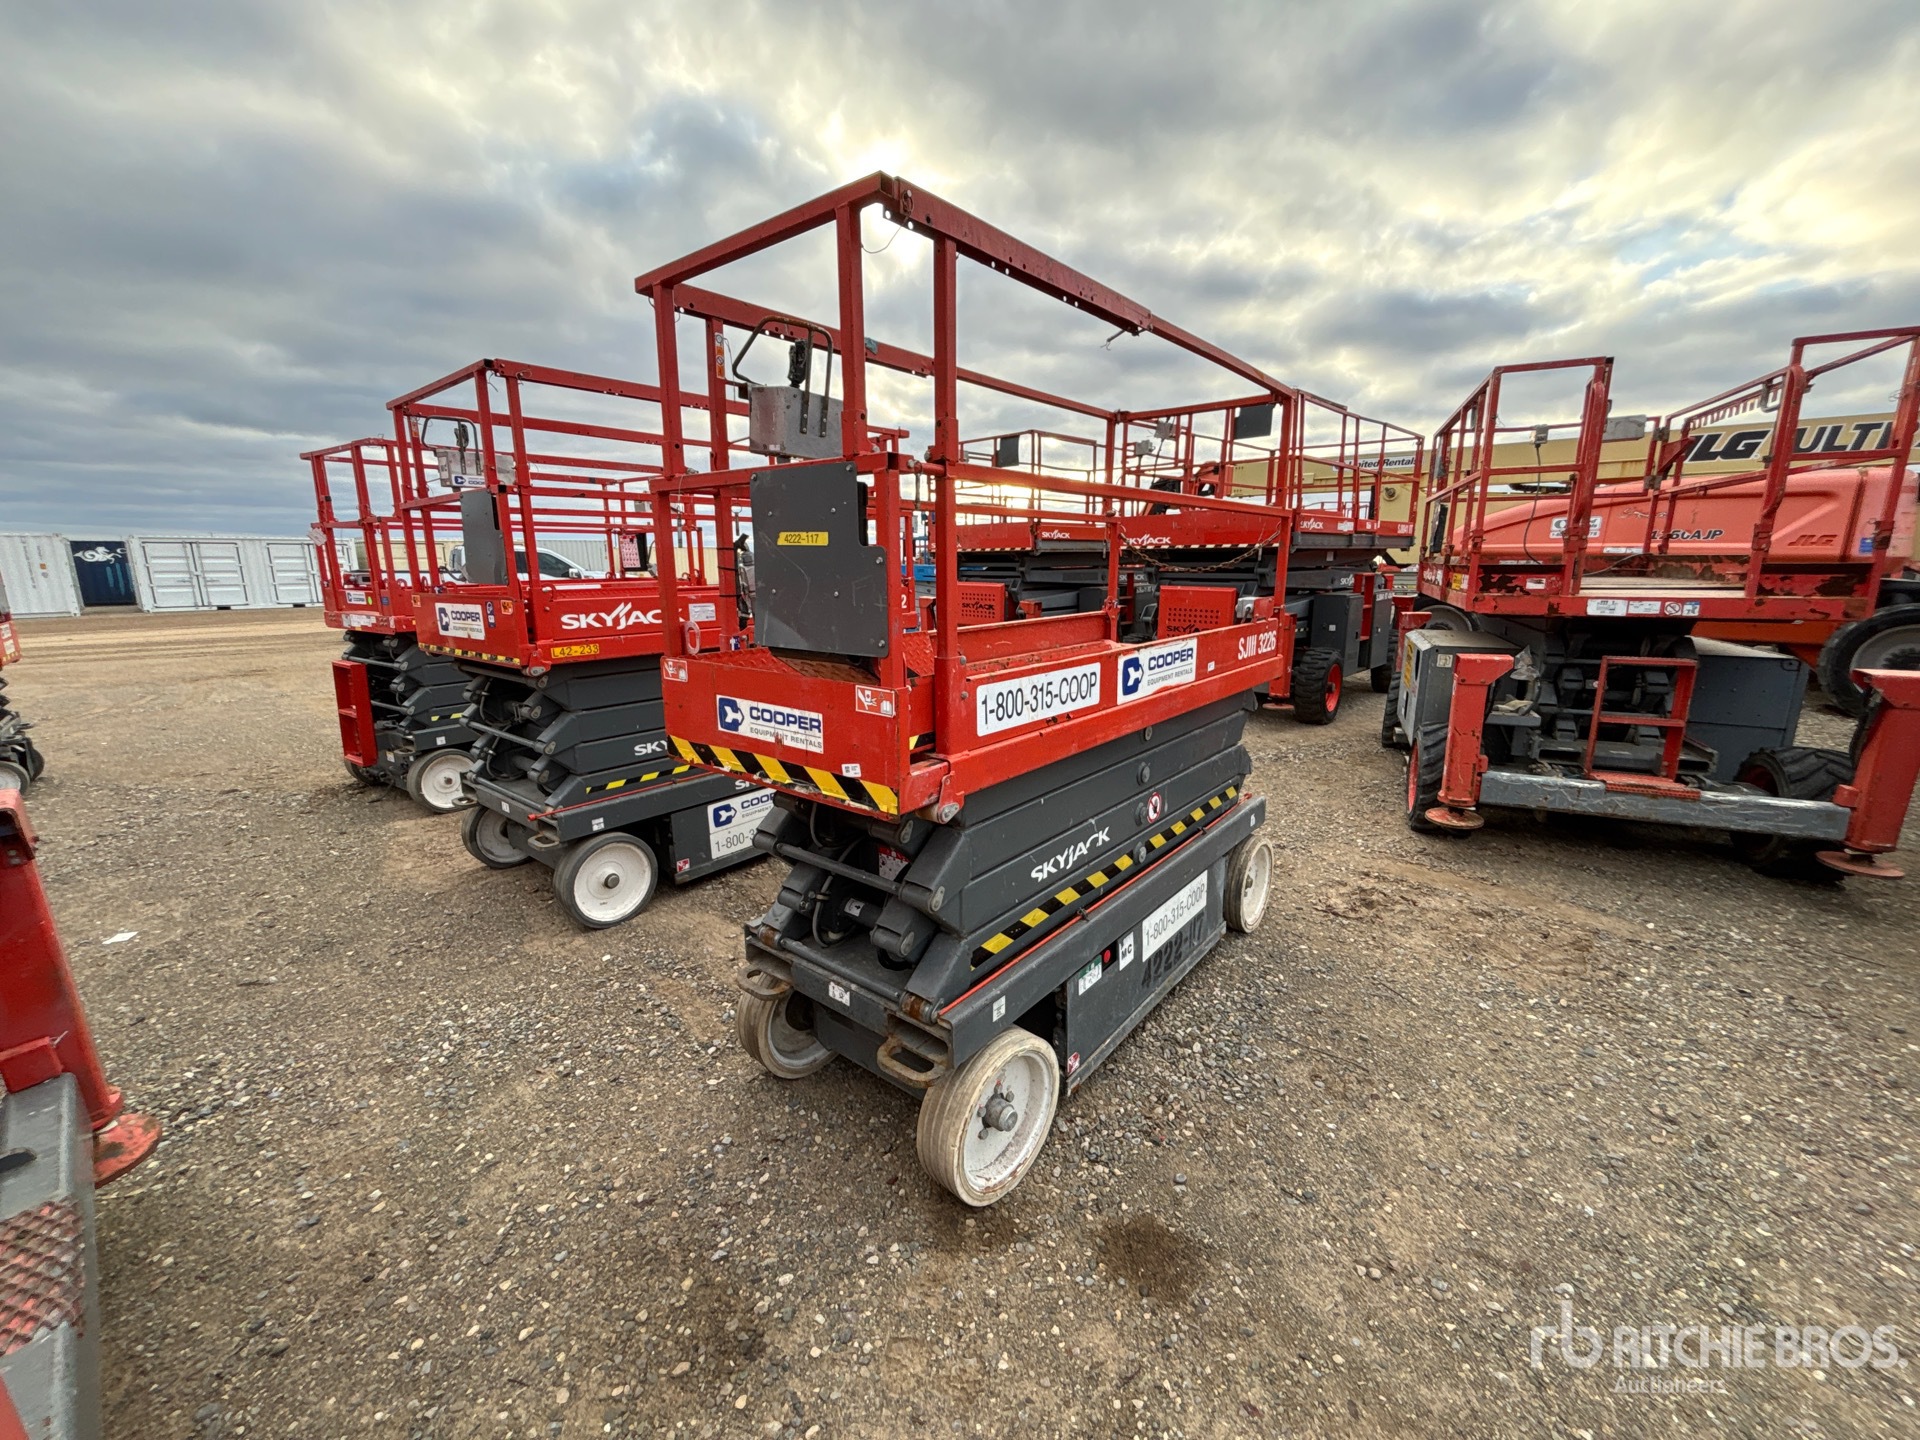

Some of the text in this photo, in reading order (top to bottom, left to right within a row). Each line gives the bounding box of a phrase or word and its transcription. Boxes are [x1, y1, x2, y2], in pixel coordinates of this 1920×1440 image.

[784, 533, 819, 544] 4222-117
[1041, 529, 1071, 540] SKYJACK
[1787, 534, 1838, 547] JLG
[961, 601, 995, 610] SKYJACK
[451, 610, 481, 622] COOPER
[1166, 624, 1210, 635] SKYJA
[1258, 630, 1277, 655] 3226
[552, 643, 599, 658] L42-233
[1148, 647, 1194, 671] COOPER
[1147, 667, 1193, 686] EQUIPMENT RENTALS
[981, 671, 1097, 725] 1-800-315-COOP
[750, 706, 822, 733] COOPER
[790, 735, 822, 749] RENTALS
[1030, 826, 1111, 883] SKYJACK
[1146, 883, 1206, 947] 1-800-315-COOP
